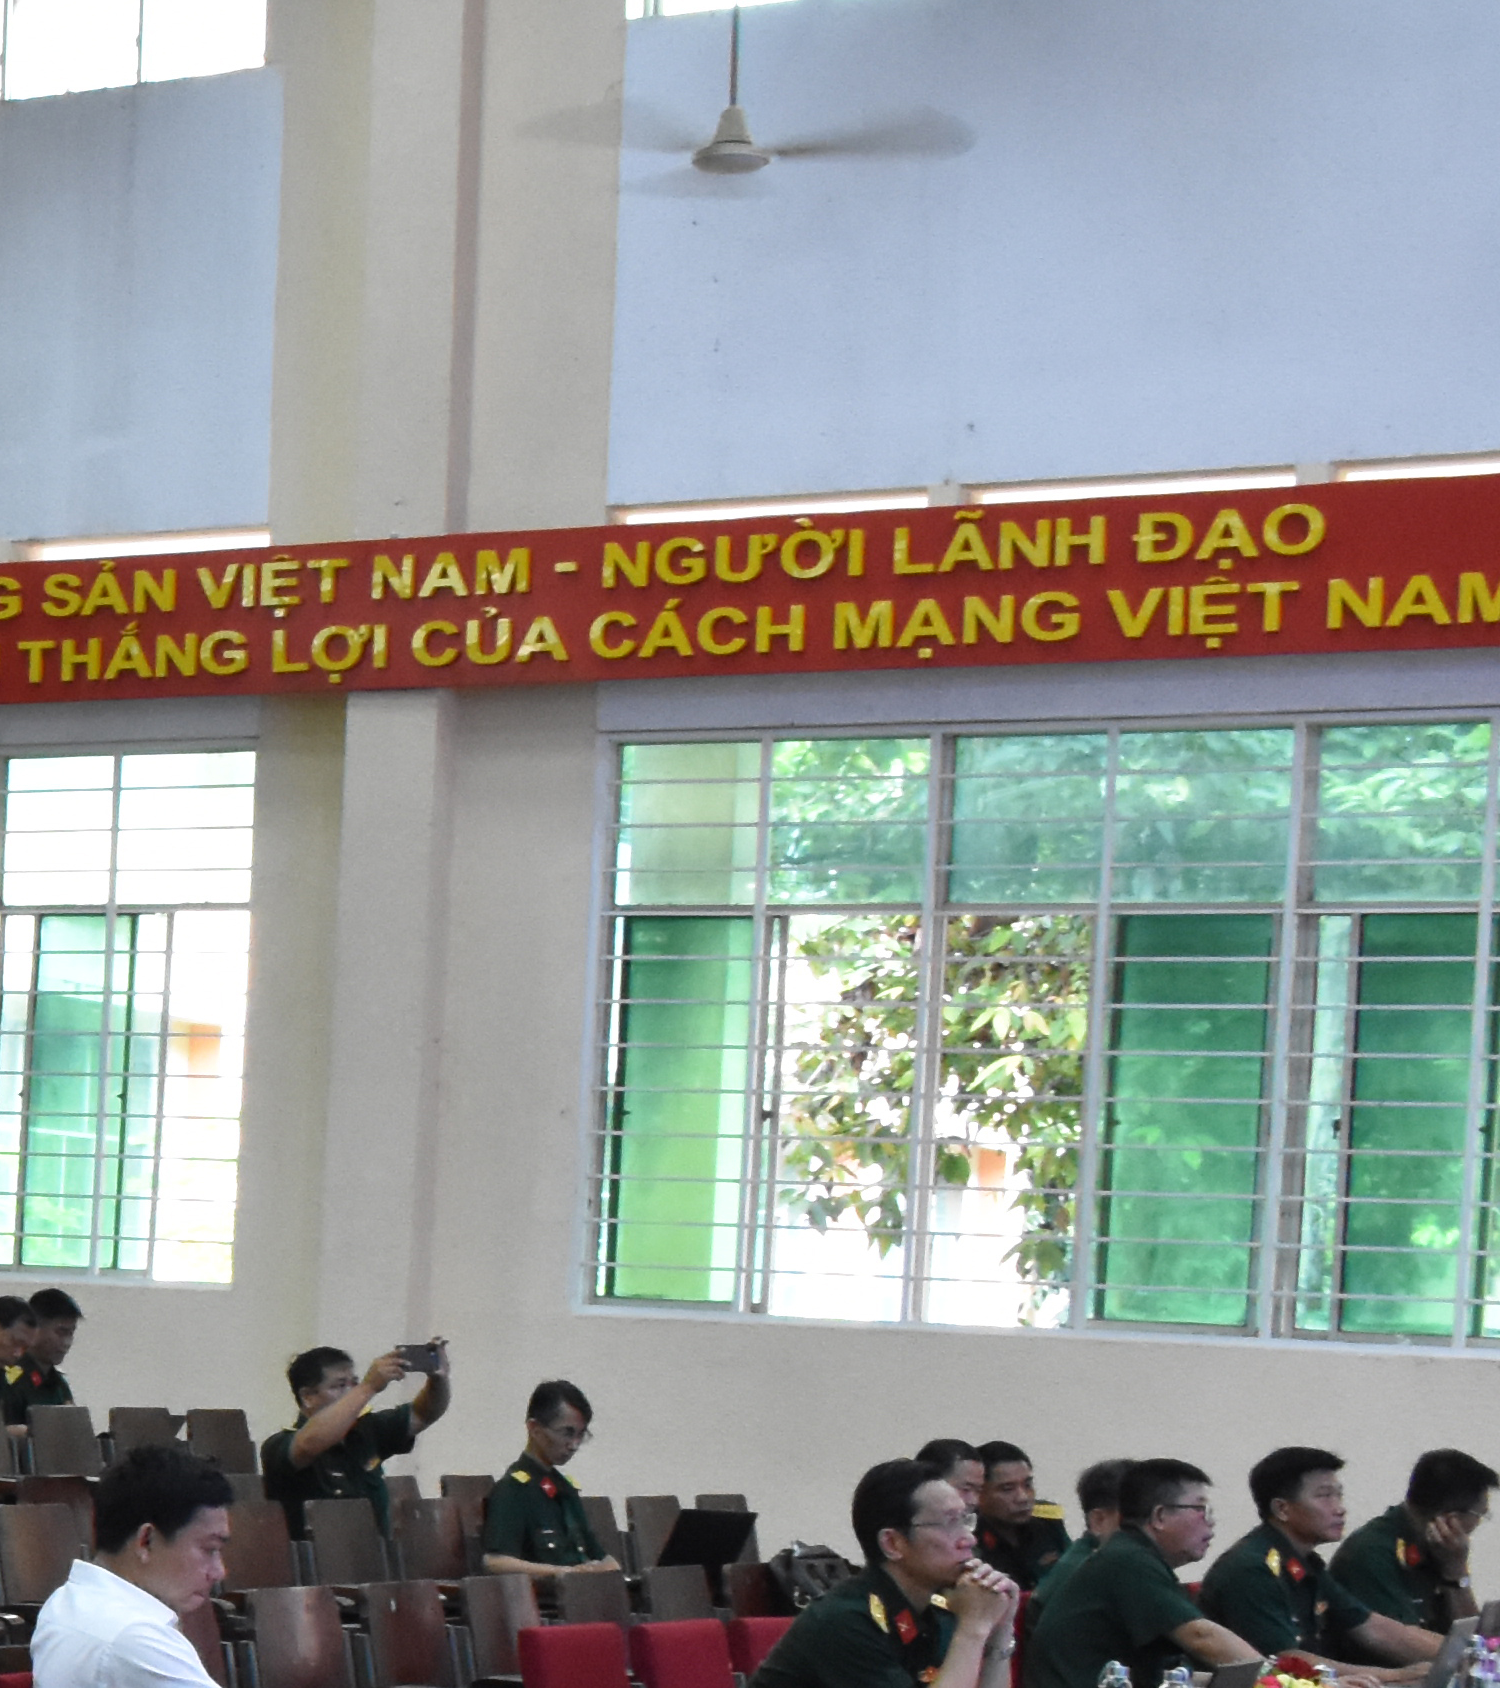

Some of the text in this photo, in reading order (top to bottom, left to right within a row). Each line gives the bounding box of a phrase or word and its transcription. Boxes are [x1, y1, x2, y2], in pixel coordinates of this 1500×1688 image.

[41, 561, 177, 618] SẢN
[197, 554, 350, 618] VIỆT
[370, 547, 532, 600] NAM
[554, 561, 579, 573] -
[601, 517, 865, 589] NGƯỜI
[892, 510, 1107, 576] LÃNH
[1131, 503, 1325, 570] ĐẠO
[17, 621, 250, 684] THẮNG
[270, 622, 390, 684] LỢI
[410, 606, 570, 668] CỦA
[588, 598, 806, 661] CÁCH
[832, 591, 1082, 660] MẠNG
[1106, 576, 1300, 649] VIỆT
[1326, 571, 1500, 630] NAM
